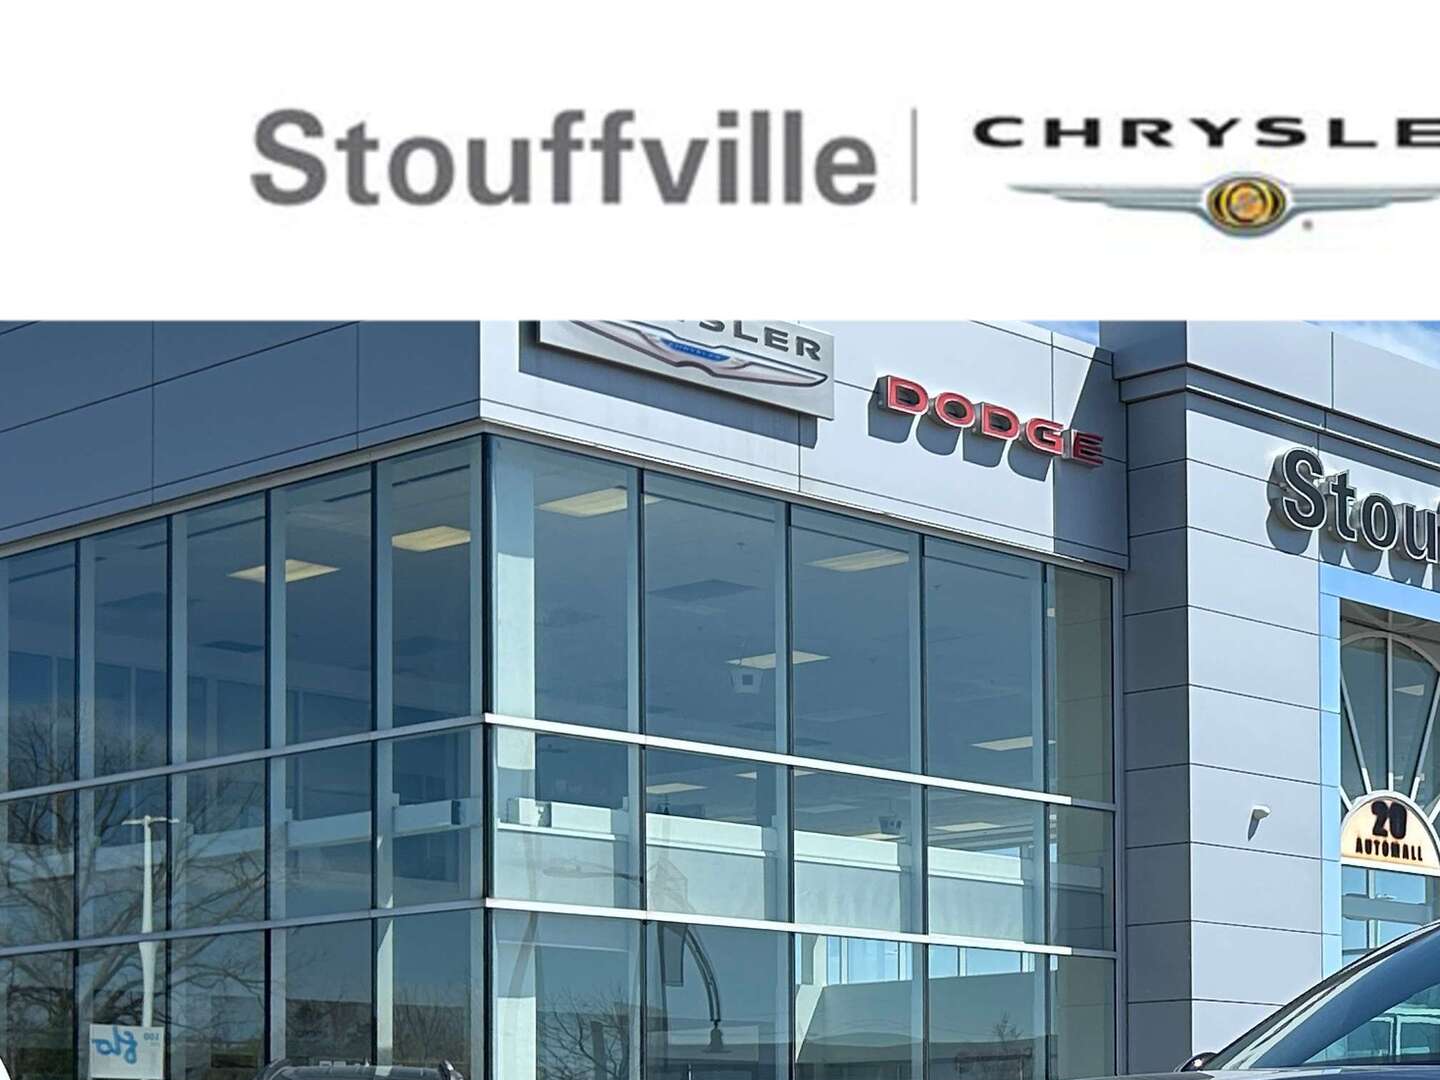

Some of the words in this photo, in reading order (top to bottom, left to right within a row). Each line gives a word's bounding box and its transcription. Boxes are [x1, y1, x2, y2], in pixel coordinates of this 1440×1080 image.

[680, 320, 821, 361] SLER
[884, 374, 1104, 466] DODGE
[1371, 800, 1408, 840] 20
[1355, 837, 1424, 862] AUTOMALL
